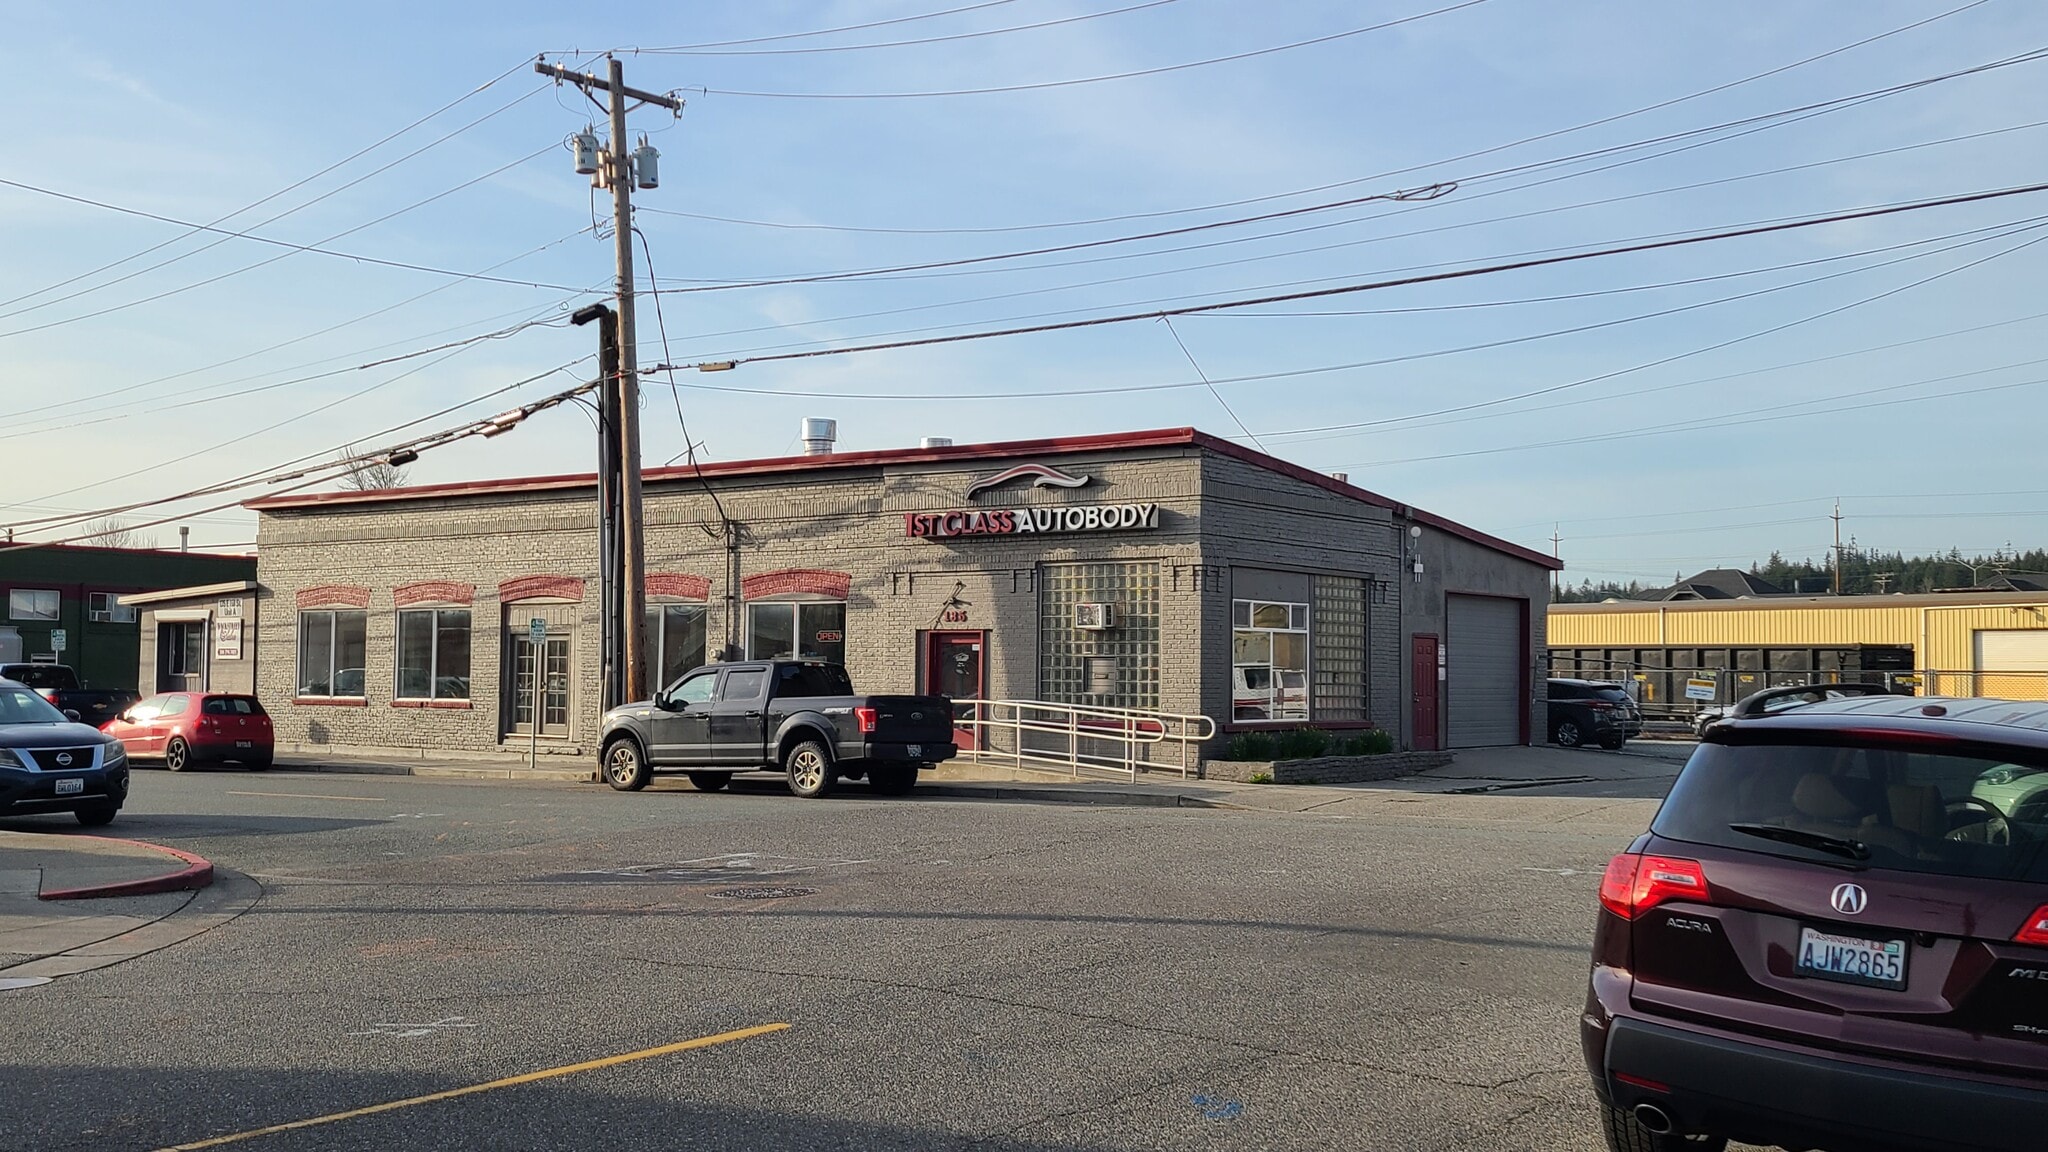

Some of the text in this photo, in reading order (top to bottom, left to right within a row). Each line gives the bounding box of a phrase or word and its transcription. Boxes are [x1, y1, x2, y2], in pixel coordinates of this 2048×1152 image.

[904, 504, 1157, 537] 1ST CLASS AUTOBODY
[817, 632, 839, 640] OPEN
[1666, 917, 1712, 933] ACURA
[1807, 931, 1866, 947] WASHINGTON
[1802, 942, 1900, 979] AJW2865
